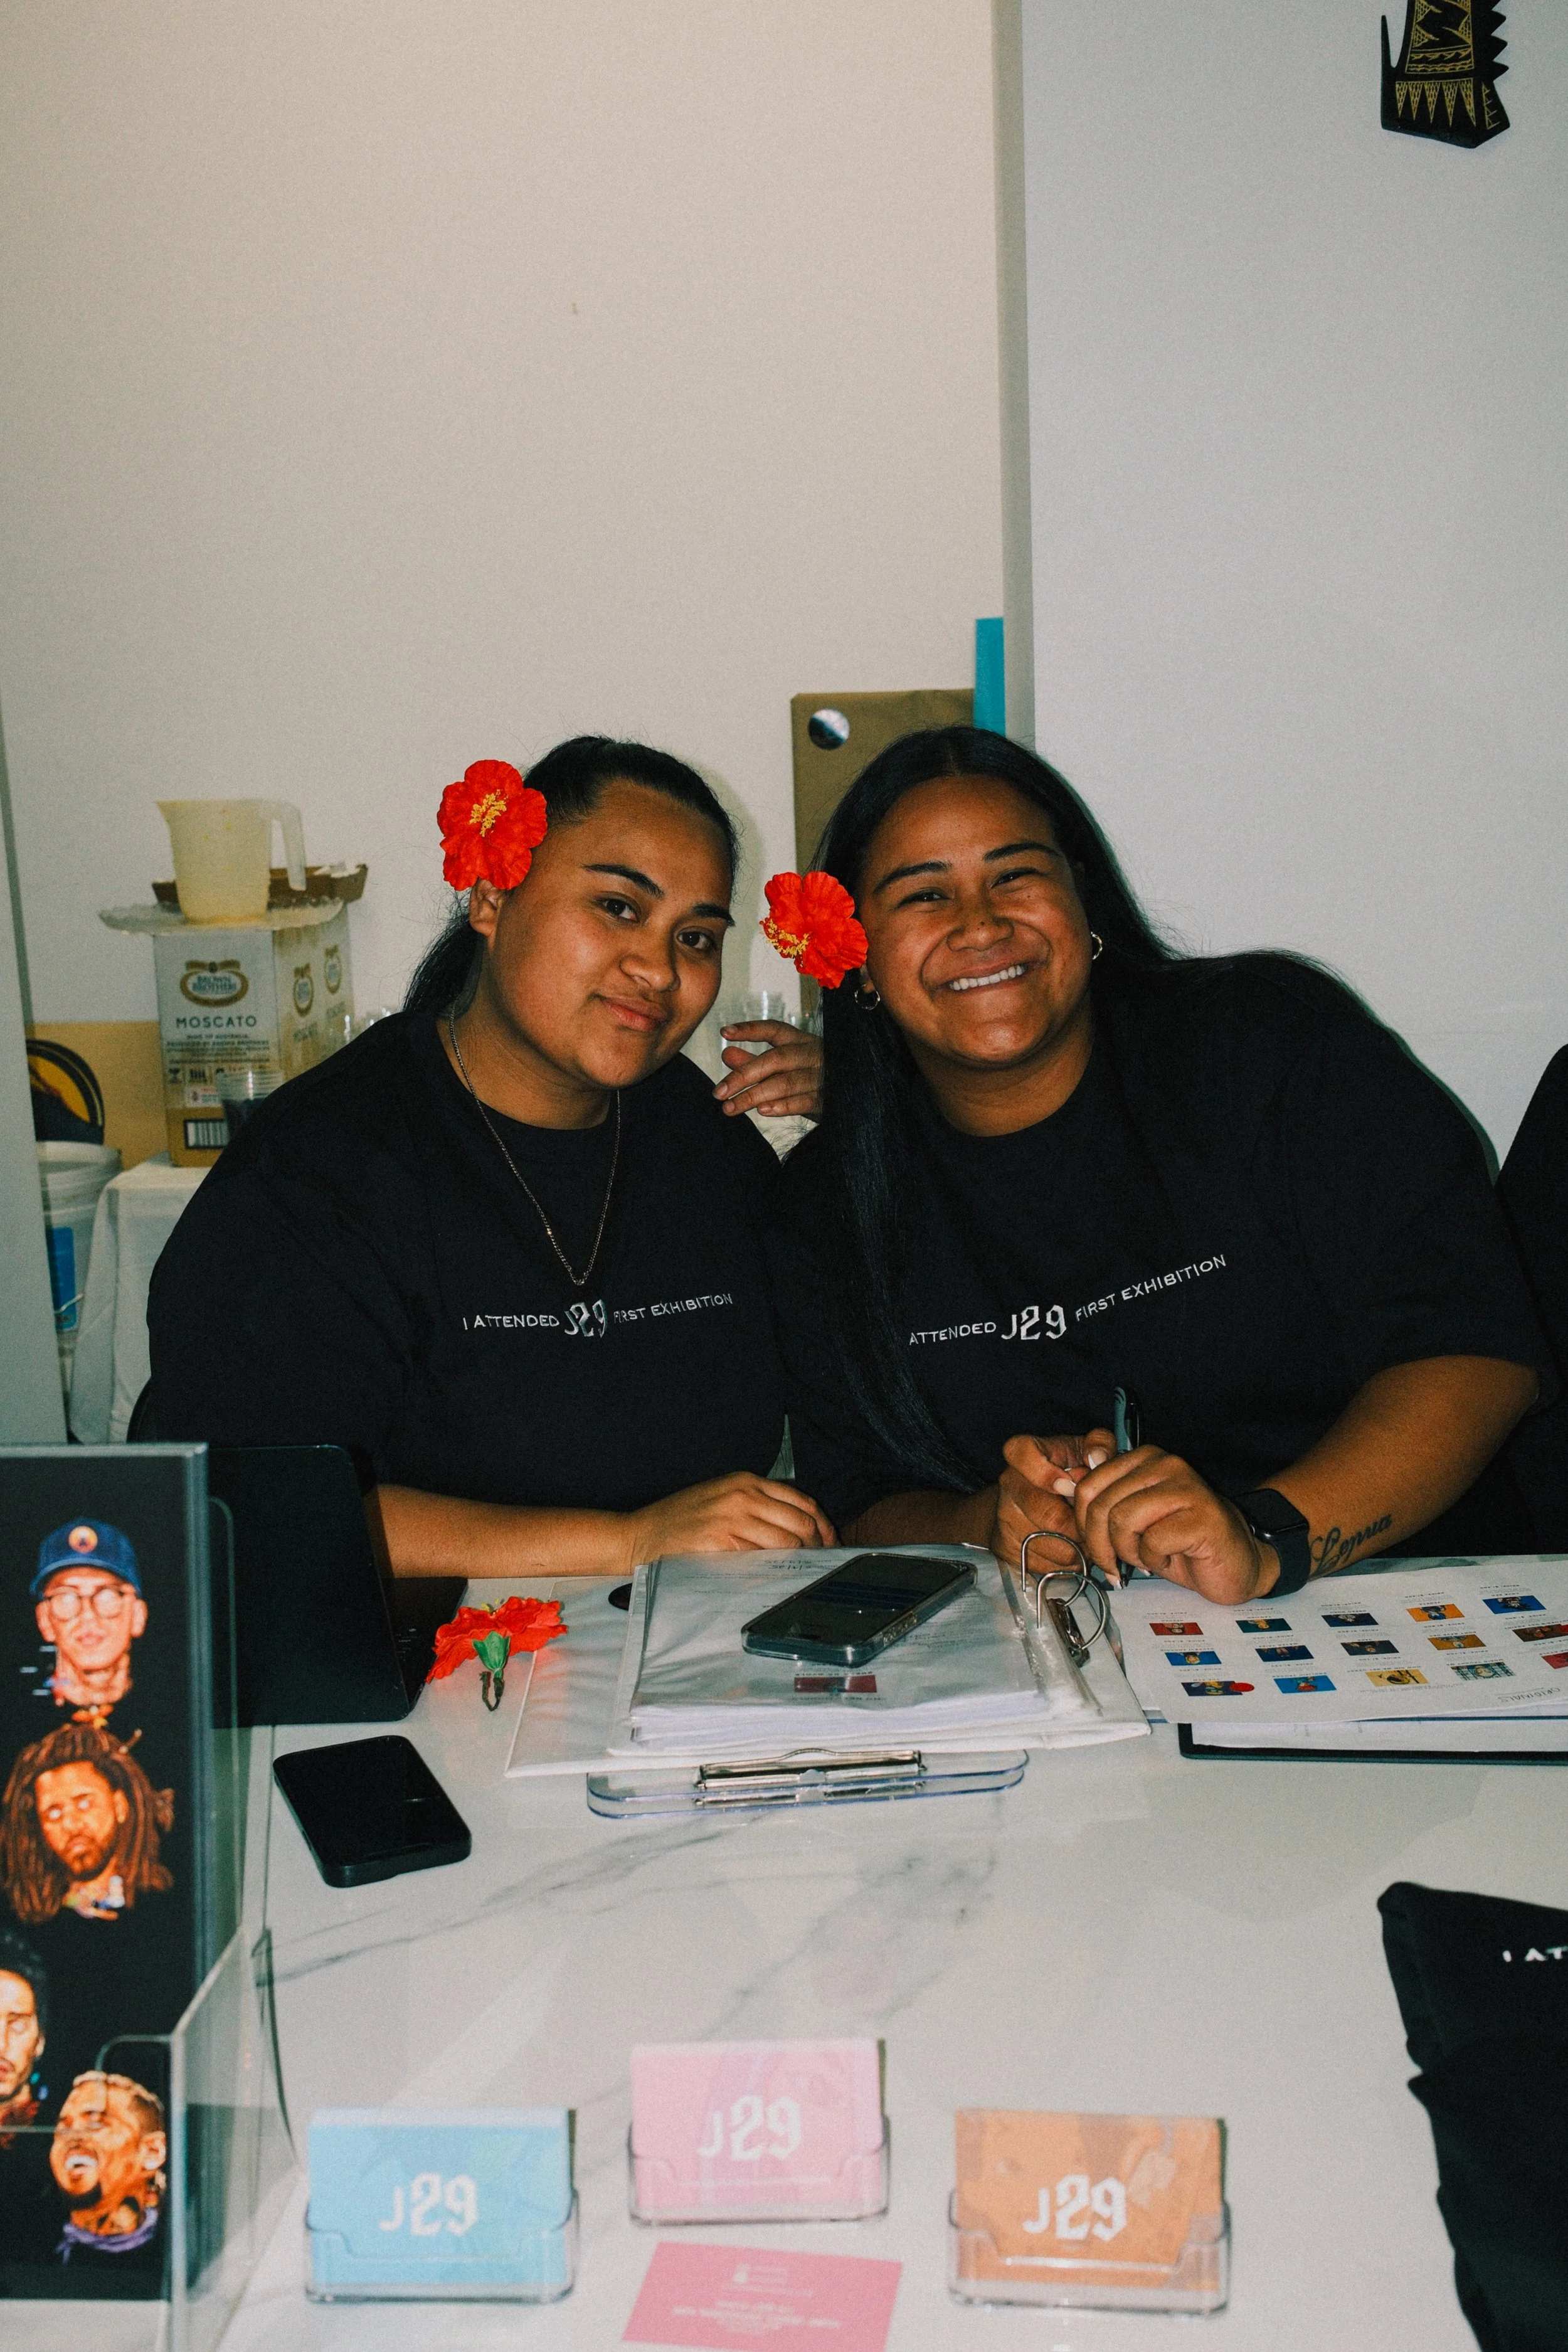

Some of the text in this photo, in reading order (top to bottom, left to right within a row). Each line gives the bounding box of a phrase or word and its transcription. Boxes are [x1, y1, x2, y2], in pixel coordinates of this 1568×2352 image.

[176, 1015, 257, 1029] MOSCATO
[462, 1293, 733, 1338] I ATTENDED J29 FIRST EXHIBITION
[909, 1254, 1227, 1345] ATTENDED J29 FIRST EXHIBITION
[1502, 1950, 1512, 1963] I
[698, 2095, 801, 2160] J29
[379, 2173, 478, 2236] J29
[1023, 2175, 1126, 2241] J29
